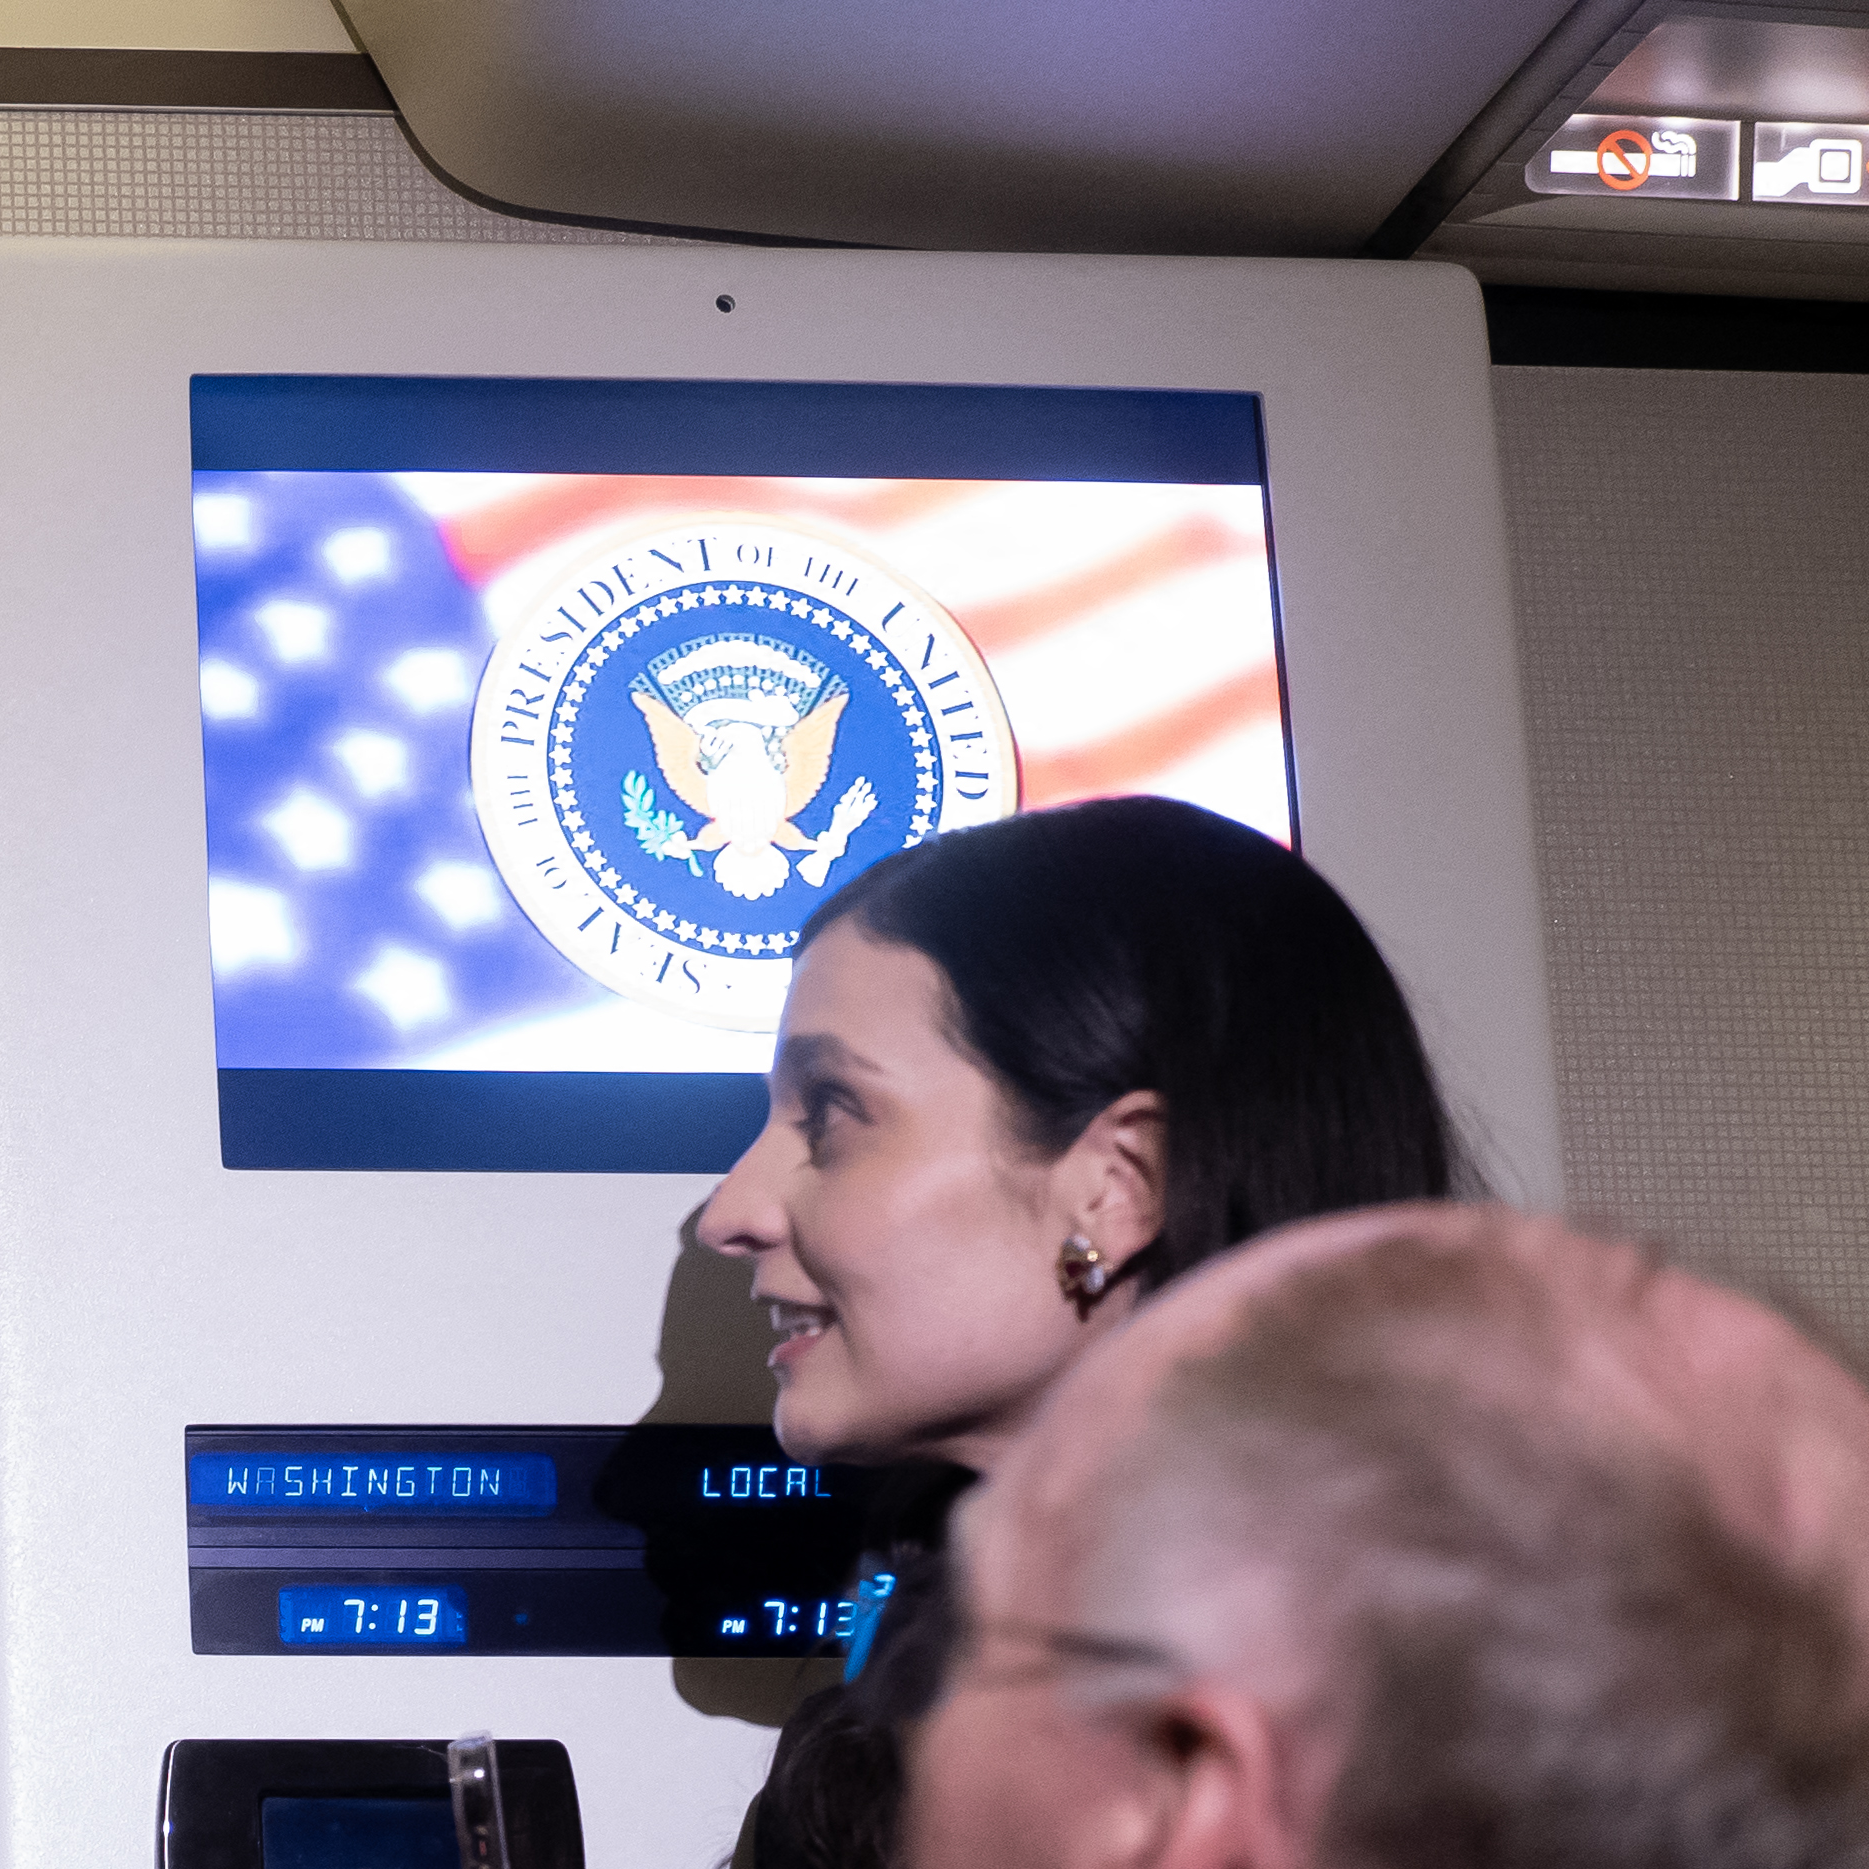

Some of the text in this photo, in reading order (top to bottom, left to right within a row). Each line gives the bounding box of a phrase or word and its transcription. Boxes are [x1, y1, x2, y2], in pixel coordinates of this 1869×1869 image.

[500, 536, 718, 747] PRESIDENT
[881, 600, 990, 800] UNITED
[226, 1465, 501, 1498] WASHINGTON
[703, 1467, 832, 1498] LOCAL
[300, 1598, 439, 1635] PM 7:13
[721, 1600, 859, 1637] PM 7:13
